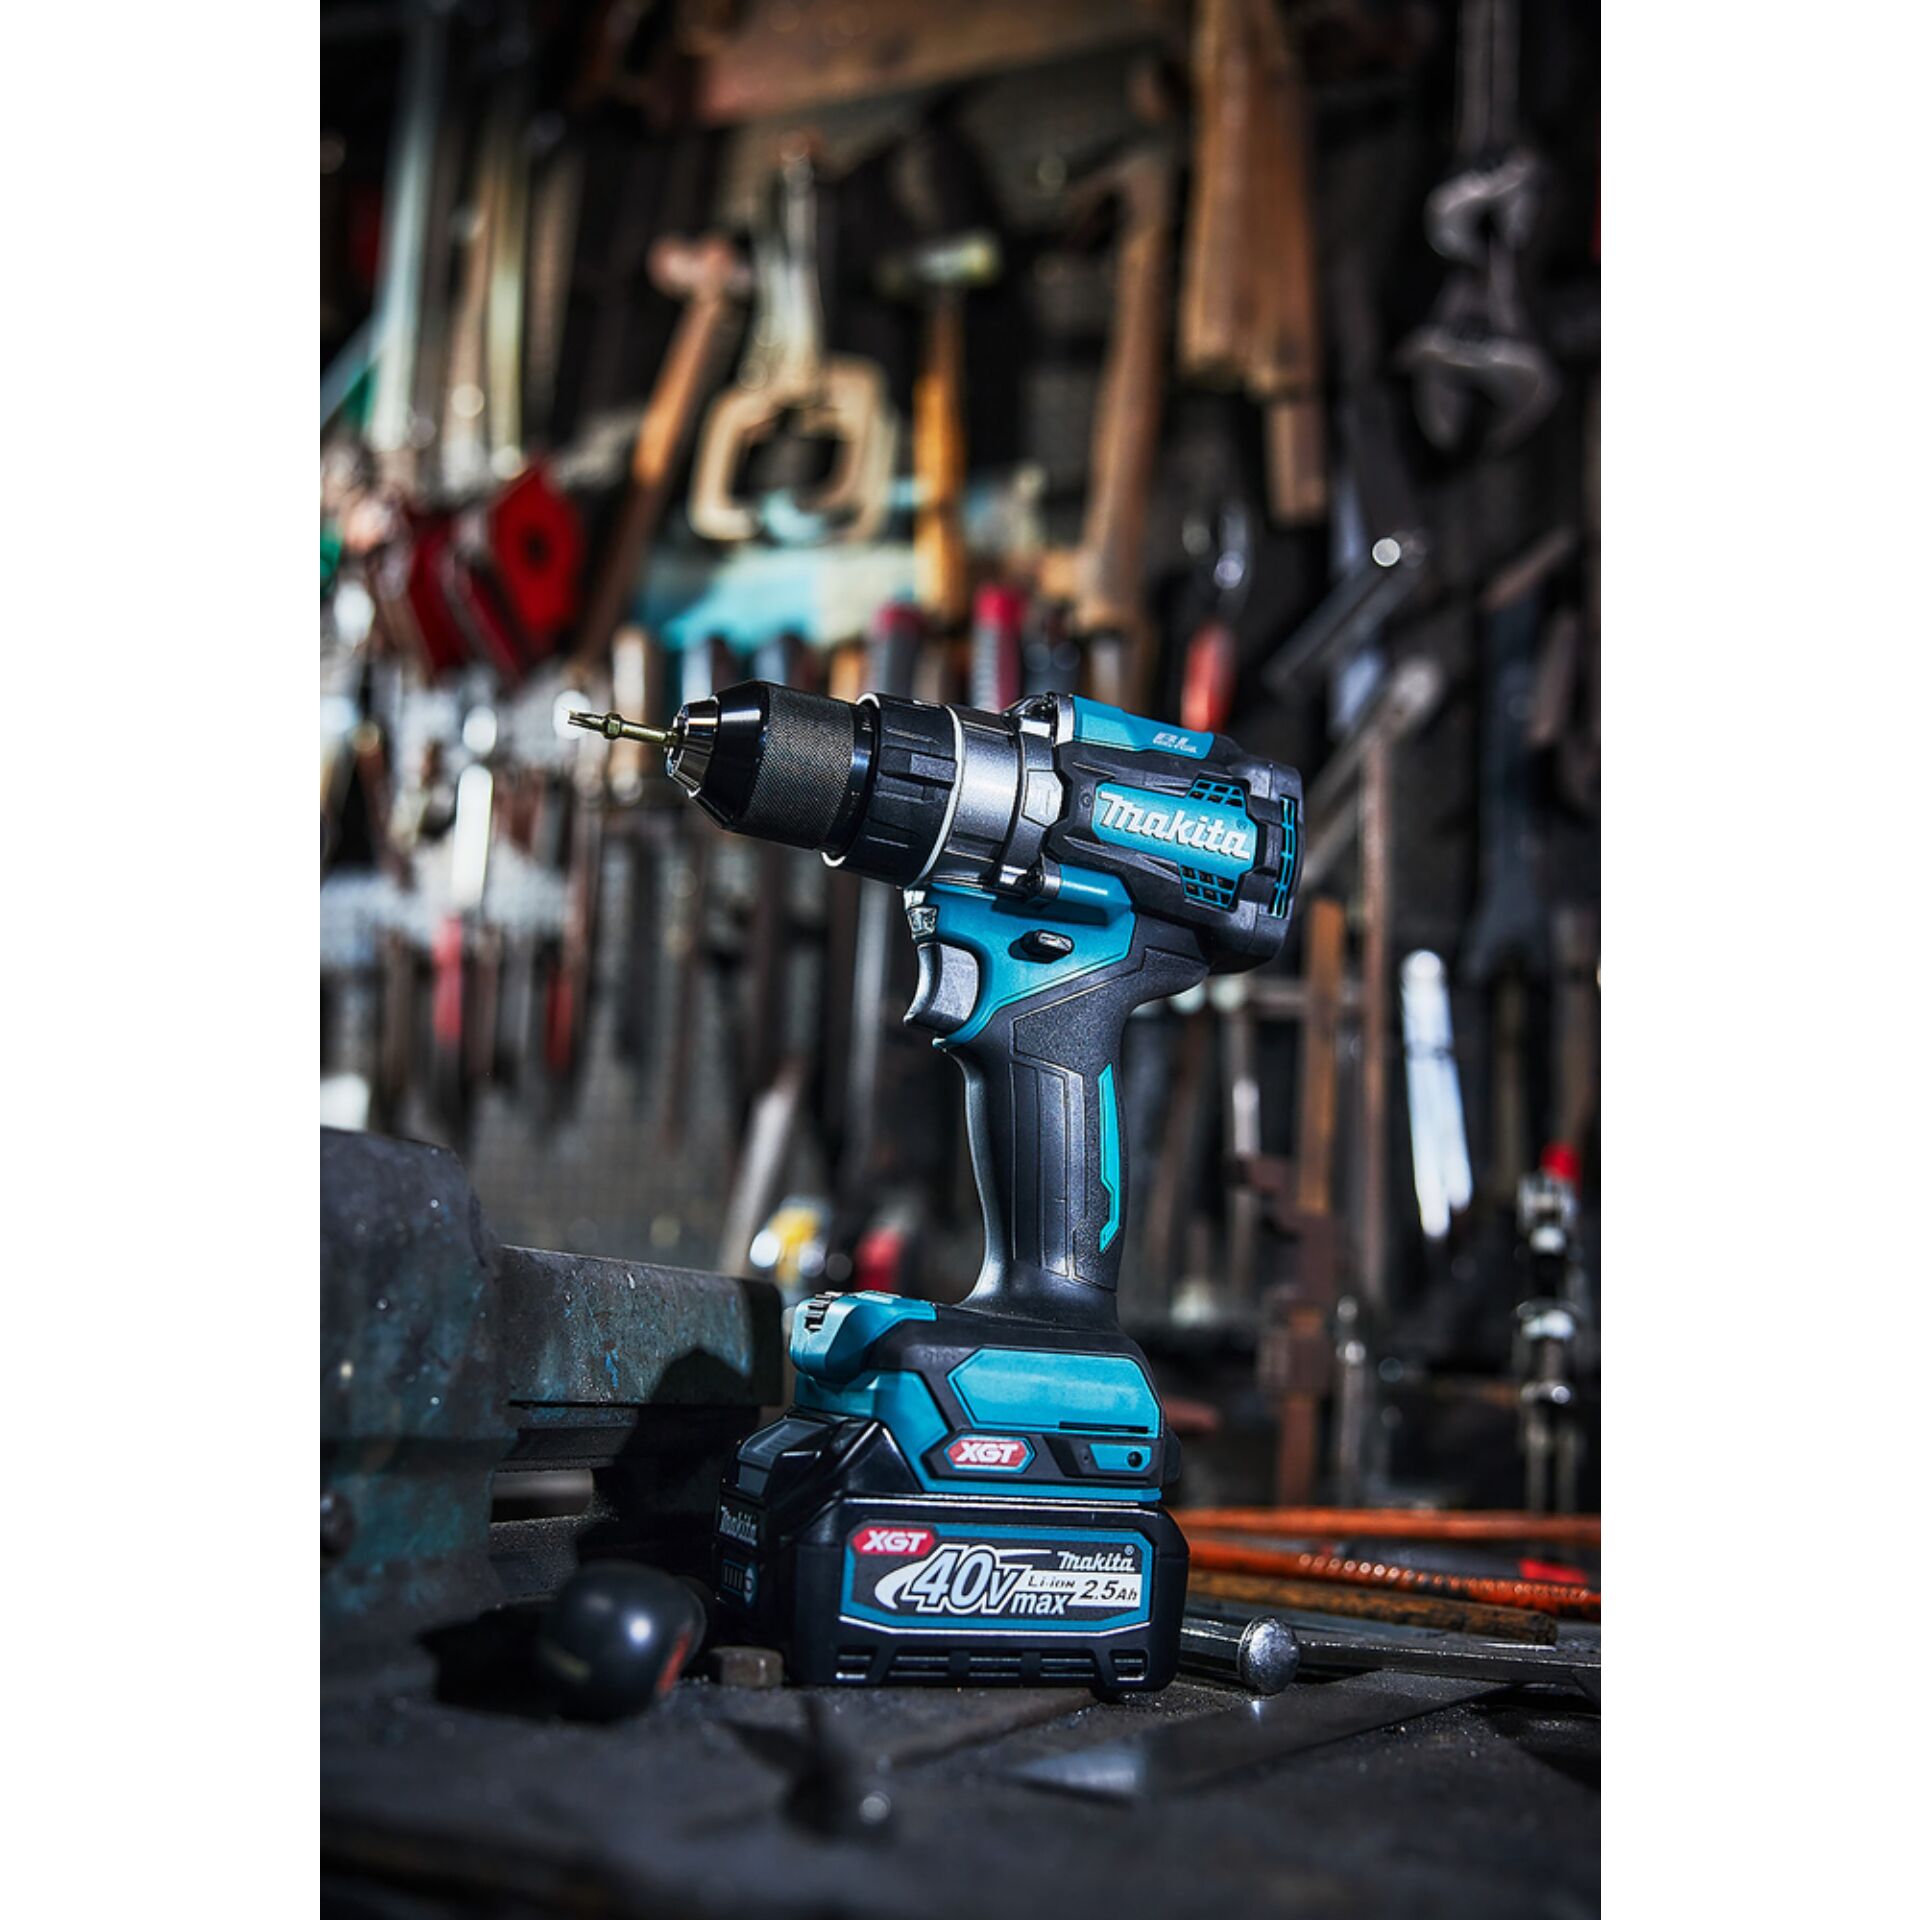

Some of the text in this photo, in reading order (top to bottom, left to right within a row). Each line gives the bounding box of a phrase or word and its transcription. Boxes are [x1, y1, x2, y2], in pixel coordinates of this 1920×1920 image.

[956, 1441, 1018, 1464] XGT
[862, 1531, 927, 1553] XGT
[1010, 1592, 1069, 1615] max
